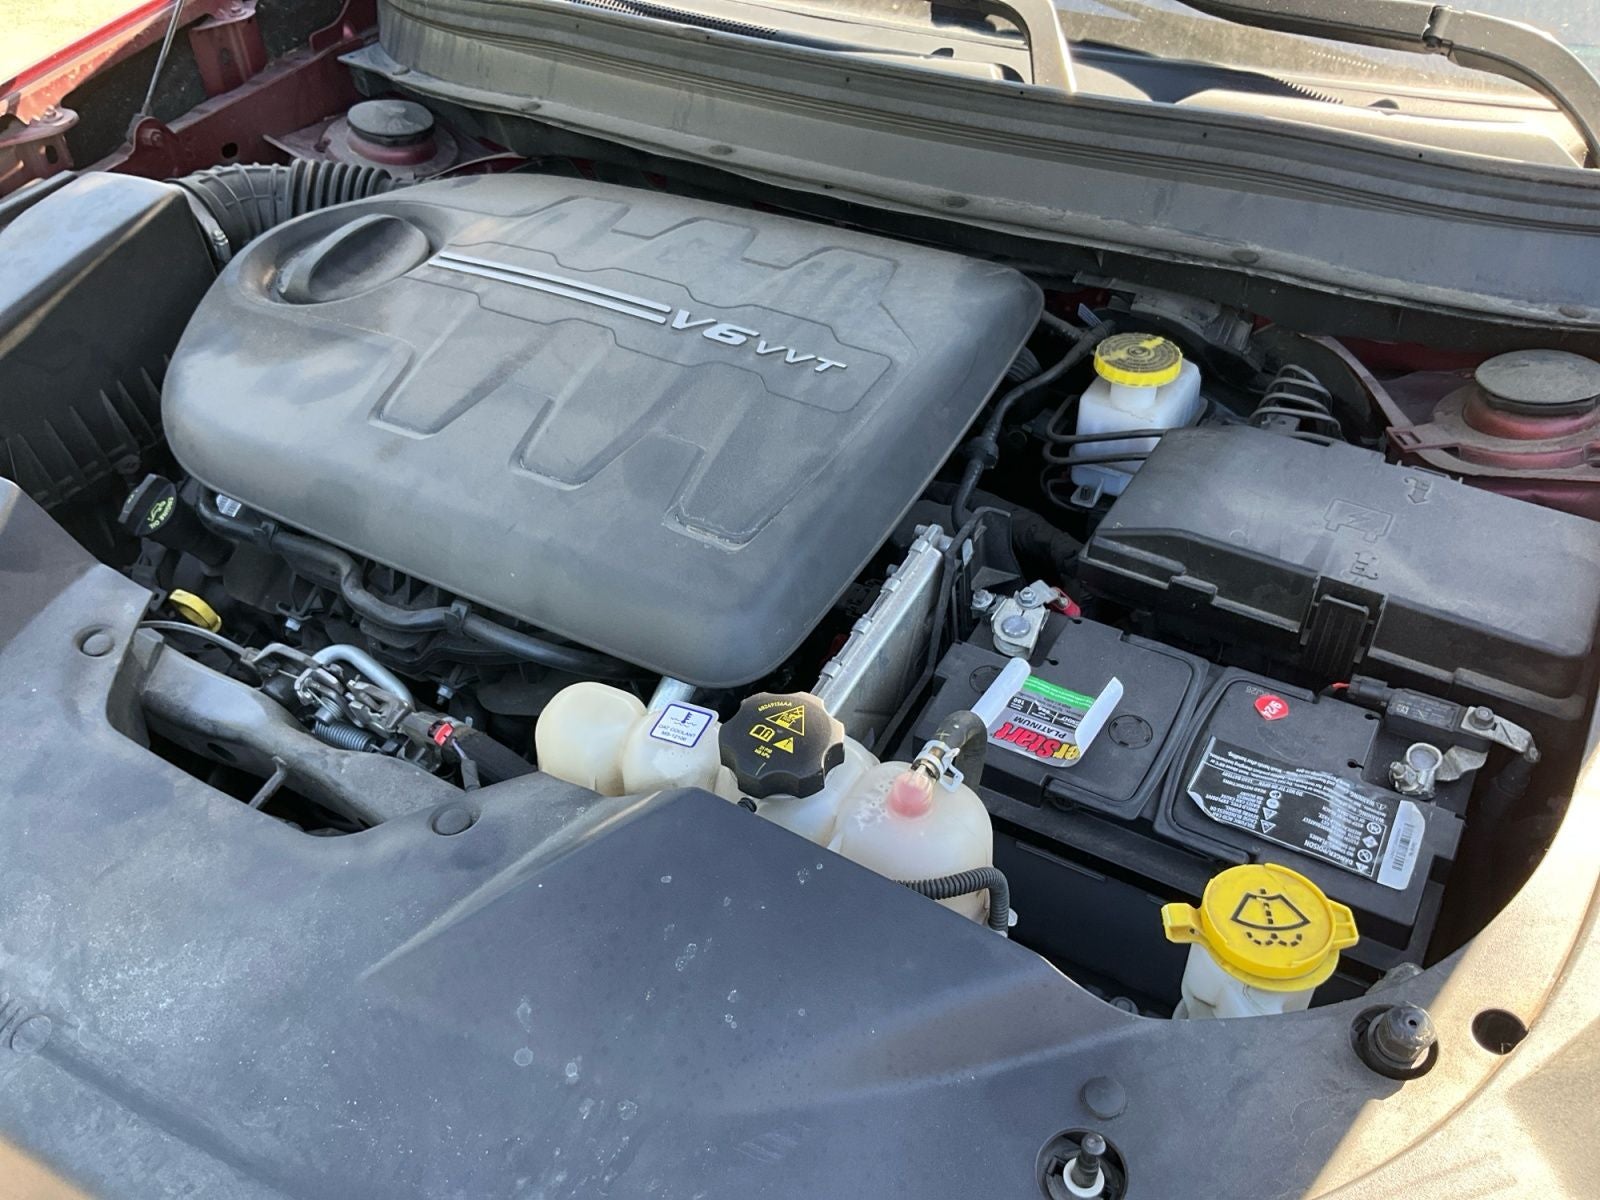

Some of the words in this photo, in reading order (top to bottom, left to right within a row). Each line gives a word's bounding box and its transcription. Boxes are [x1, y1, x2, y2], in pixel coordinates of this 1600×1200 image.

[671, 309, 760, 346] V6
[756, 340, 848, 373] VVT
[1261, 701, 1282, 719] 9/24
[670, 727, 696, 738] COOLANT
[1013, 715, 1067, 739] PLATINUM
[993, 721, 1080, 760] erStart
[1303, 839, 1354, 865] DANGER/POISON
